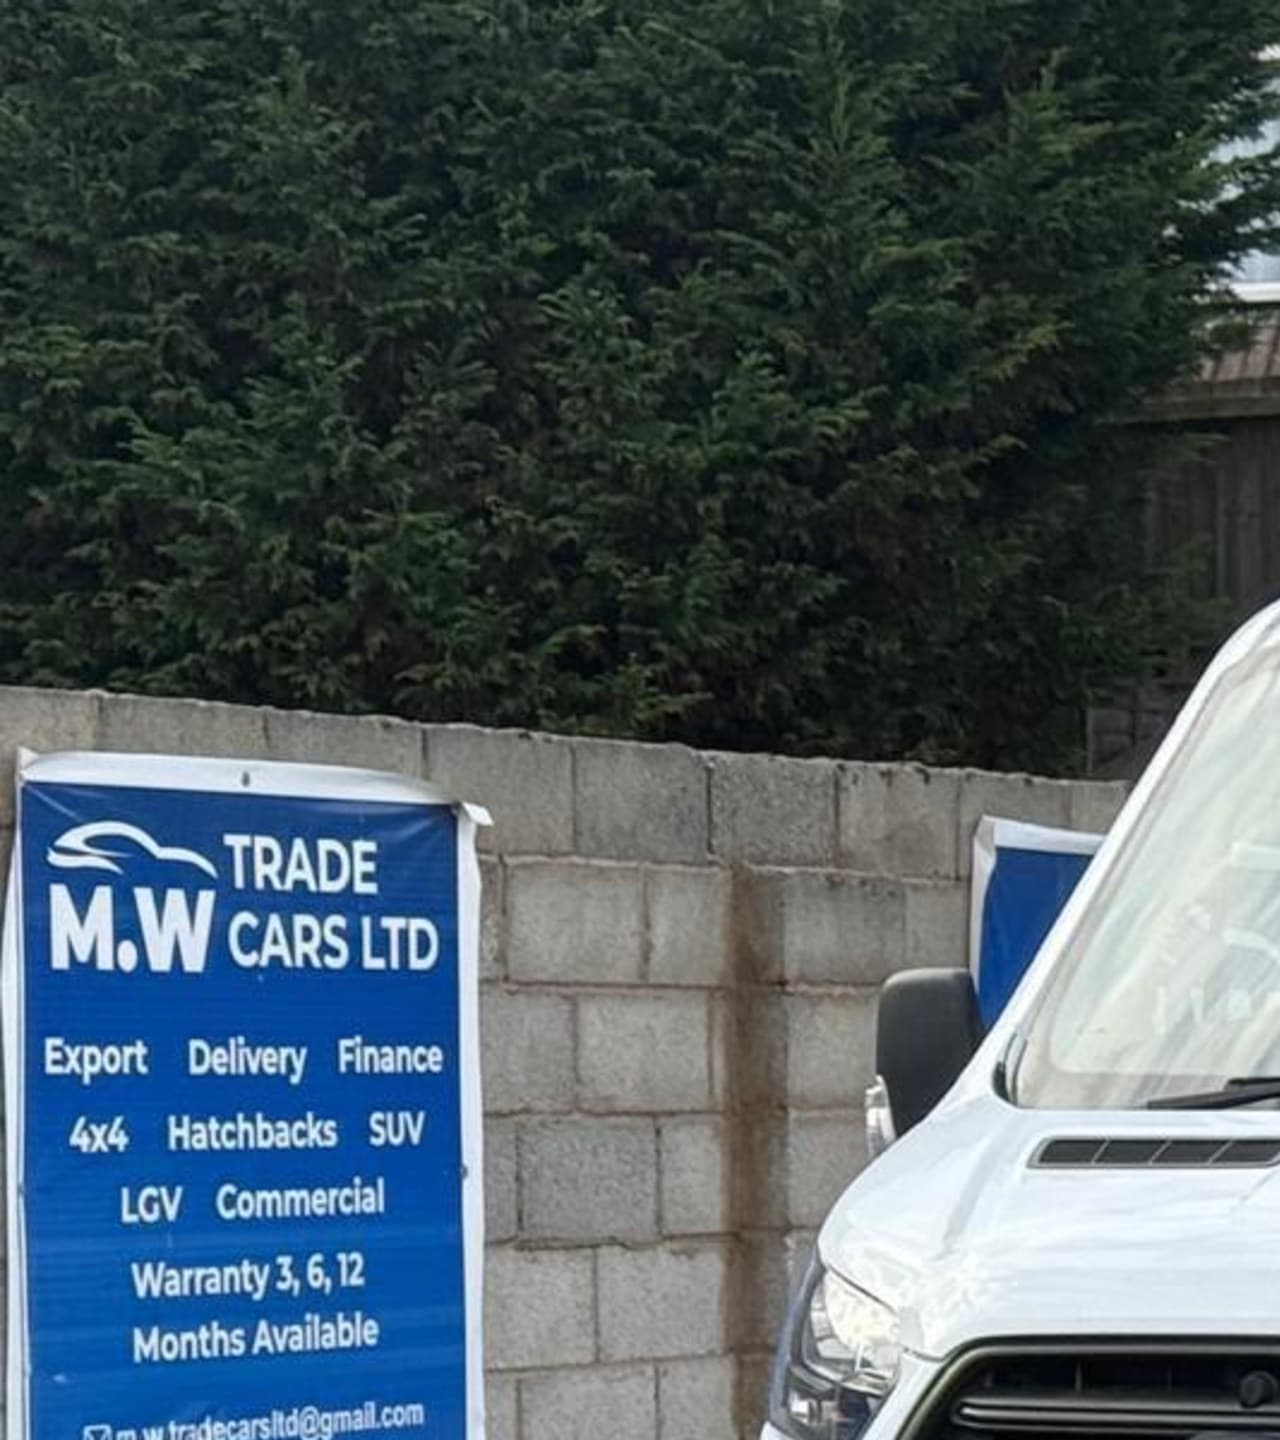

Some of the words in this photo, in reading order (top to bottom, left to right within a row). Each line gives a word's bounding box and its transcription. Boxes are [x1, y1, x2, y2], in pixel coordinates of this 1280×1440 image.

[224, 834, 377, 893] TRADE
[50, 884, 215, 972] M.W
[229, 911, 349, 968] CARS
[362, 916, 438, 970] LTD
[45, 1038, 148, 1084] Export
[189, 1036, 307, 1084] Delivery
[339, 1036, 443, 1073] Finance
[70, 1117, 128, 1152] 4x4
[169, 1112, 337, 1150] Hatchbacks
[370, 1112, 424, 1146] SUV
[122, 1187, 182, 1223] LGV
[217, 1177, 384, 1219] Commercial
[132, 1260, 269, 1300] Warranty
[276, 1256, 300, 1296] 3,
[307, 1254, 332, 1293] 6,
[337, 1252, 364, 1286] 12
[134, 1322, 245, 1362] Months
[252, 1312, 379, 1354] Available
